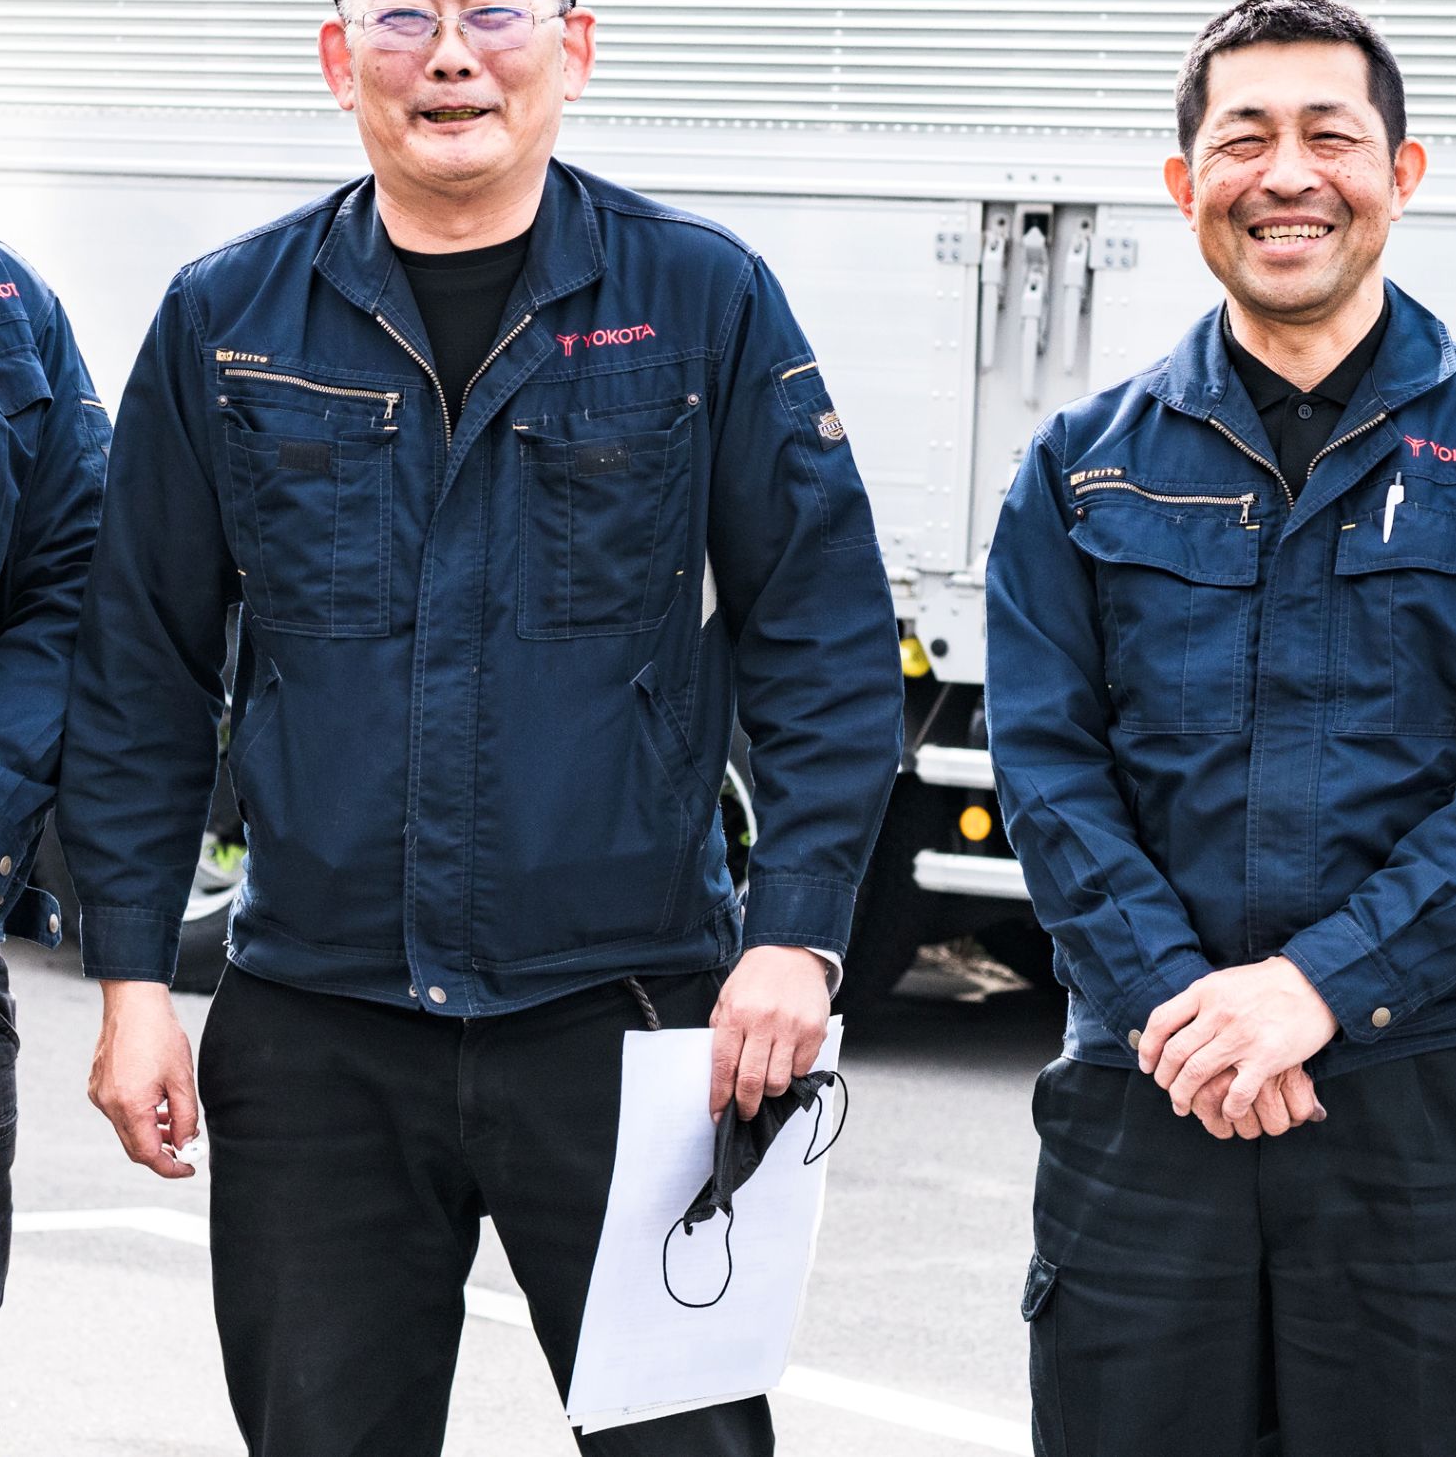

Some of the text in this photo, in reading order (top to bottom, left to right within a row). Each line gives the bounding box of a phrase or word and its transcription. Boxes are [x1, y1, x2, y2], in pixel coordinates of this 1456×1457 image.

[582, 323, 656, 348] YOKOTA
[234, 352, 268, 363] AZITO
[1087, 468, 1122, 479] AZITO
